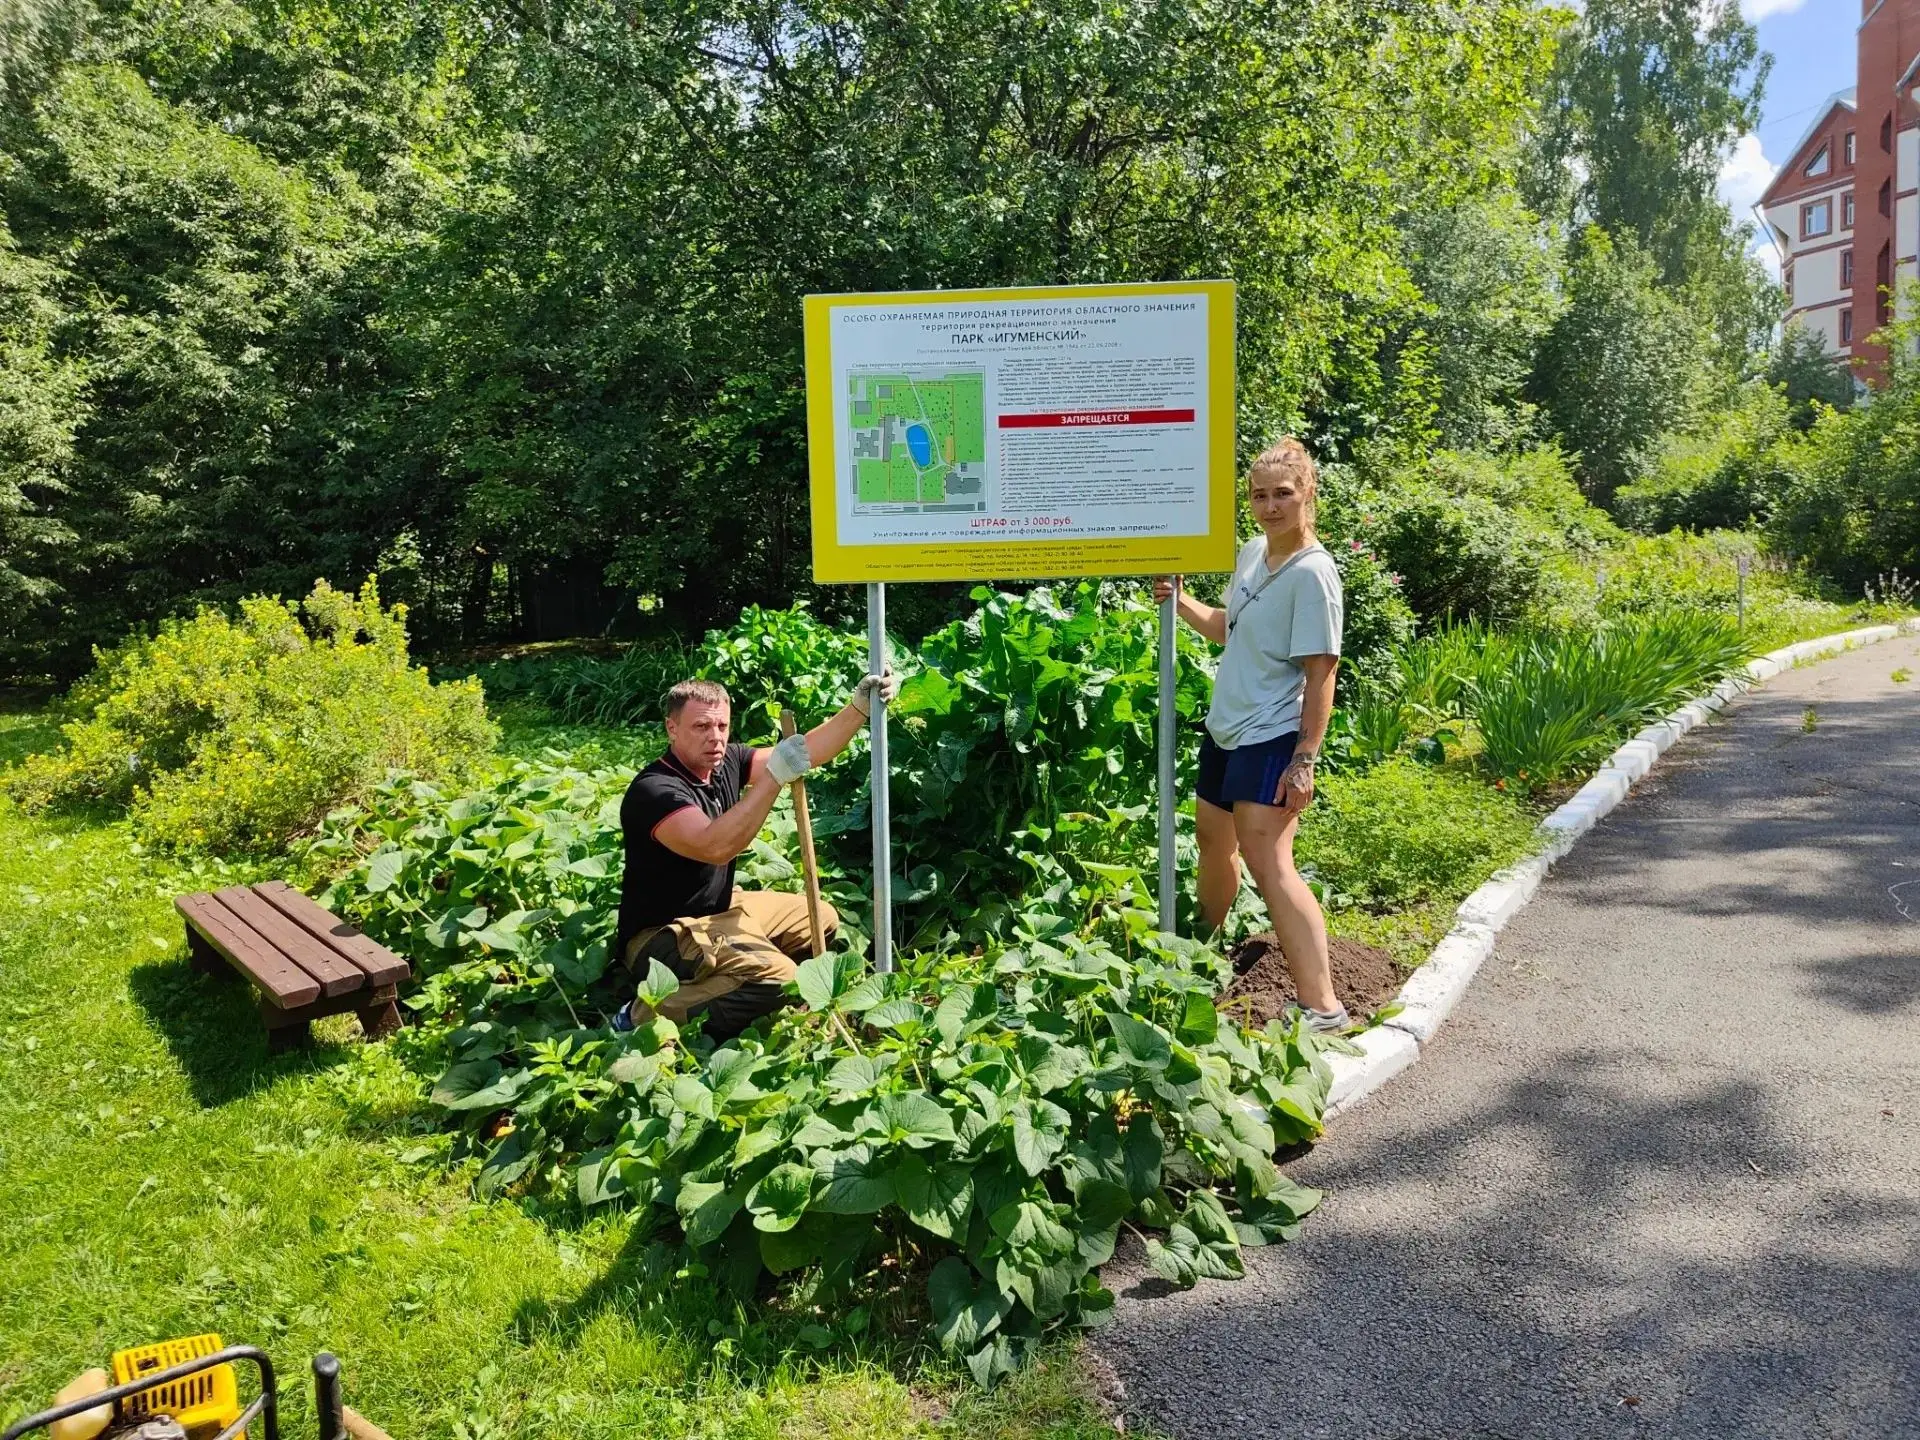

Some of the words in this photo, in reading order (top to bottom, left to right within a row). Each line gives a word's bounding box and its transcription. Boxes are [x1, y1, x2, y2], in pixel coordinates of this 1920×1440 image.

[843, 314, 877, 323] ОСОБО
[879, 311, 944, 322] ОХРАНЯЕМАЯ
[948, 309, 1007, 320] ПРИРОДНАЯ
[1010, 307, 1072, 317] ТЕРРИТОРИЯ
[1075, 305, 1141, 315] ОБЛАСТНОГО
[1144, 303, 1196, 312] ЗНАЧЕНИЯ
[921, 322, 976, 332] территория
[979, 320, 1058, 331] рекреационного
[1061, 318, 1117, 327] назначения
[951, 333, 984, 345] ПАРК
[987, 328, 1087, 344] «ИГУМЕНСКИЙ»
[1060, 414, 1130, 425] ЗАПРЕЩАЕТСЯ
[970, 518, 1008, 528] ШТРАФ
[1010, 518, 1021, 526] от
[1024, 517, 1029, 526] 3
[1032, 517, 1050, 526] 000
[1053, 516, 1074, 528] руб.
[873, 530, 929, 538] Уничтожение
[950, 529, 1006, 538] повреждение
[1008, 526, 1085, 536] информационных
[1087, 525, 1116, 533] знаков
[1119, 523, 1168, 532] запрещено!
